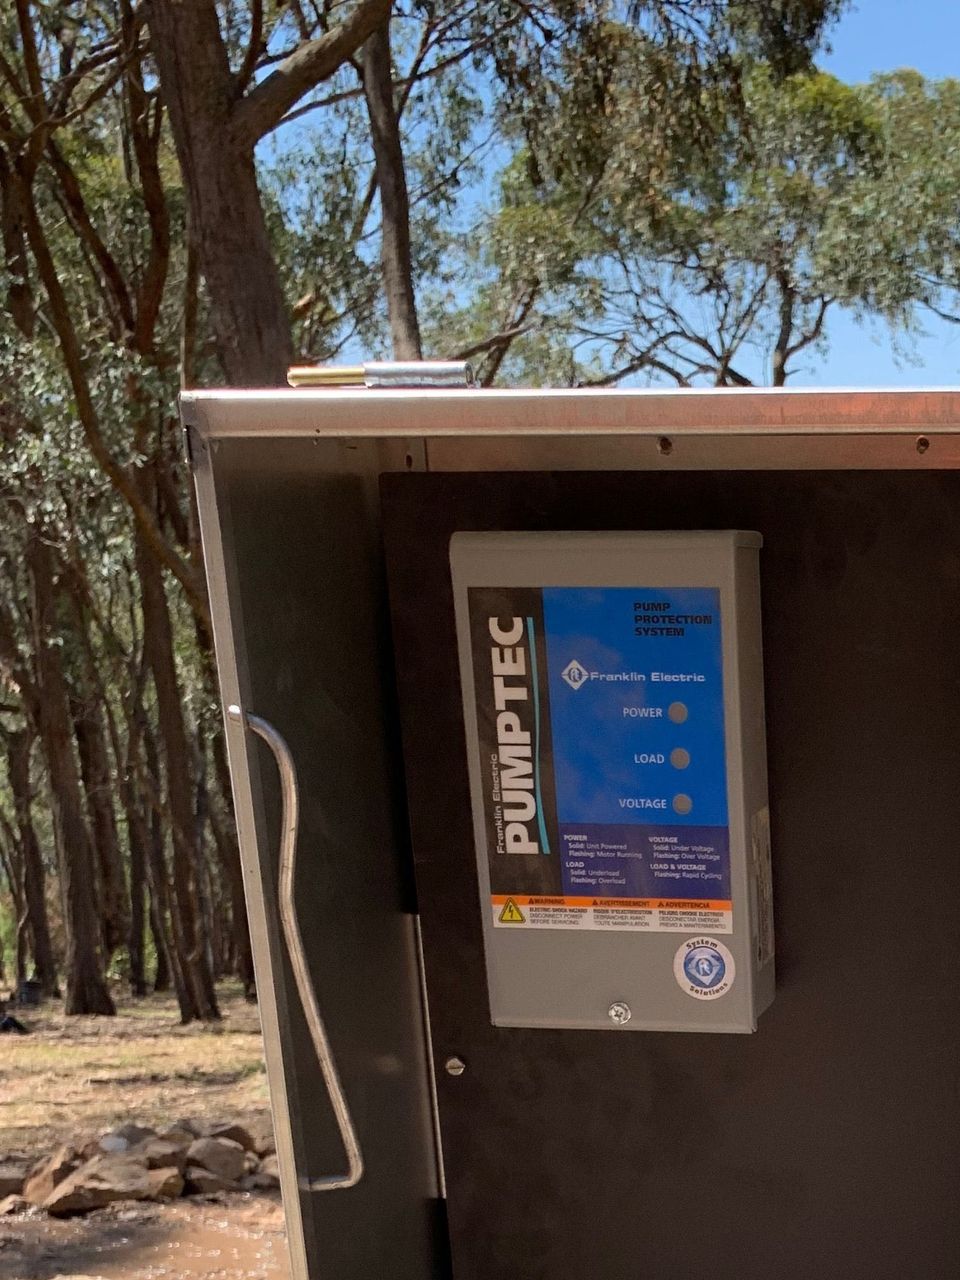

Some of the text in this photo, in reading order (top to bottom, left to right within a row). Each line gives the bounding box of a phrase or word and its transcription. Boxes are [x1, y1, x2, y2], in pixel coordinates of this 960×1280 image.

[634, 602, 671, 612] PUMP
[634, 614, 712, 625] PROTECTION
[634, 627, 685, 637] SYSTEM
[590, 671, 706, 682] Franklin Electric
[623, 707, 663, 718] POWER
[488, 617, 539, 854] PUMPTEC
[634, 754, 665, 765] LOAD
[491, 754, 505, 854] Franklin Electric
[618, 798, 667, 809] VOLTAGE
[686, 939, 718, 950] System
[689, 983, 728, 996] Solutions
